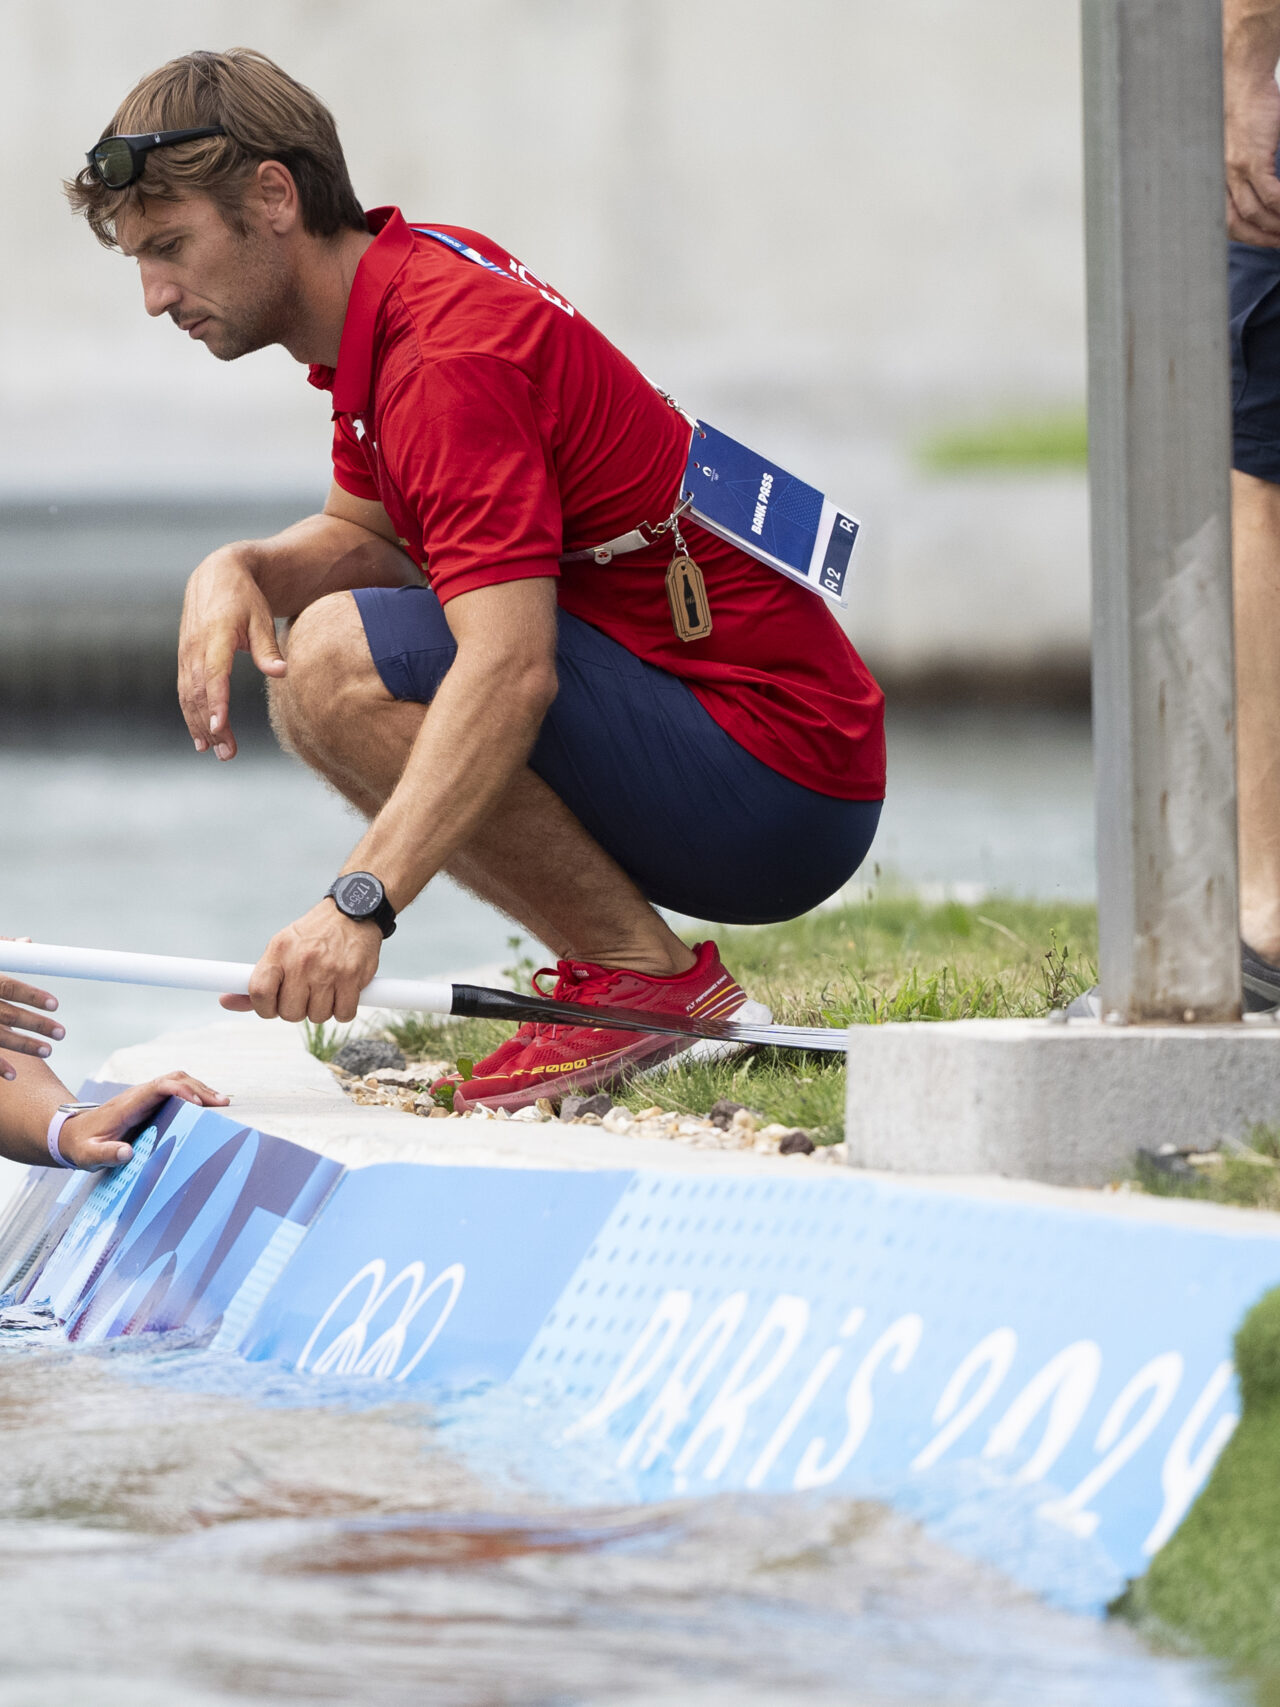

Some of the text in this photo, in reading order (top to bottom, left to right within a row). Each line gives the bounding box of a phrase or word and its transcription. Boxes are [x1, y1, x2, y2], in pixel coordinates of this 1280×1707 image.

[751, 472, 775, 536] BANK PASS
[839, 518, 855, 534] R
[685, 1001, 696, 1012] FLY
